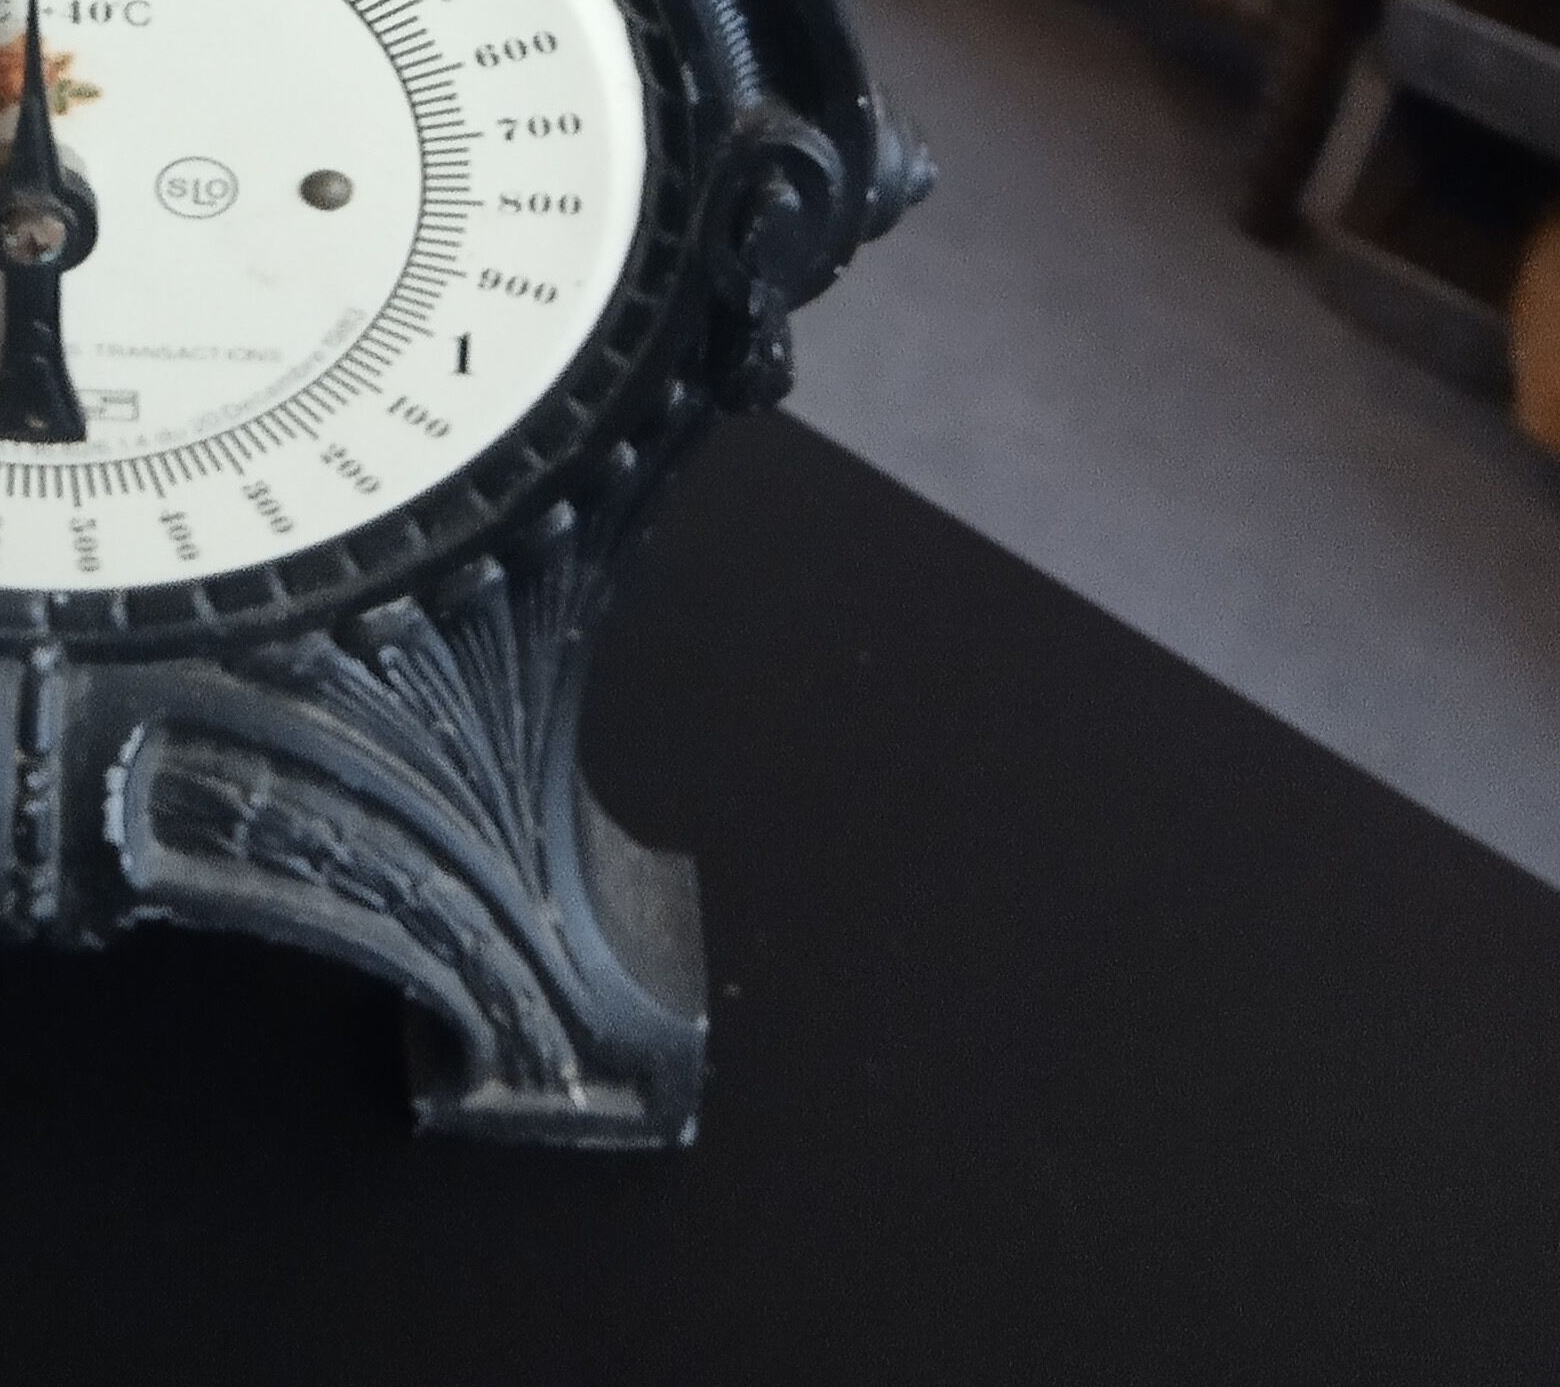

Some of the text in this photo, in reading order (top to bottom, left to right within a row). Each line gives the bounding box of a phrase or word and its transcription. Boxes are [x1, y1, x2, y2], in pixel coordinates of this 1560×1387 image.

[473, 30, 560, 69] 600
[496, 112, 584, 143] 700
[498, 192, 584, 217] 800
[476, 266, 559, 306] 900
[451, 330, 473, 378] 1
[386, 394, 452, 440] 100
[319, 443, 381, 496] 200
[241, 480, 295, 535] 300
[69, 517, 101, 574] 500
[157, 510, 199, 562] 400
